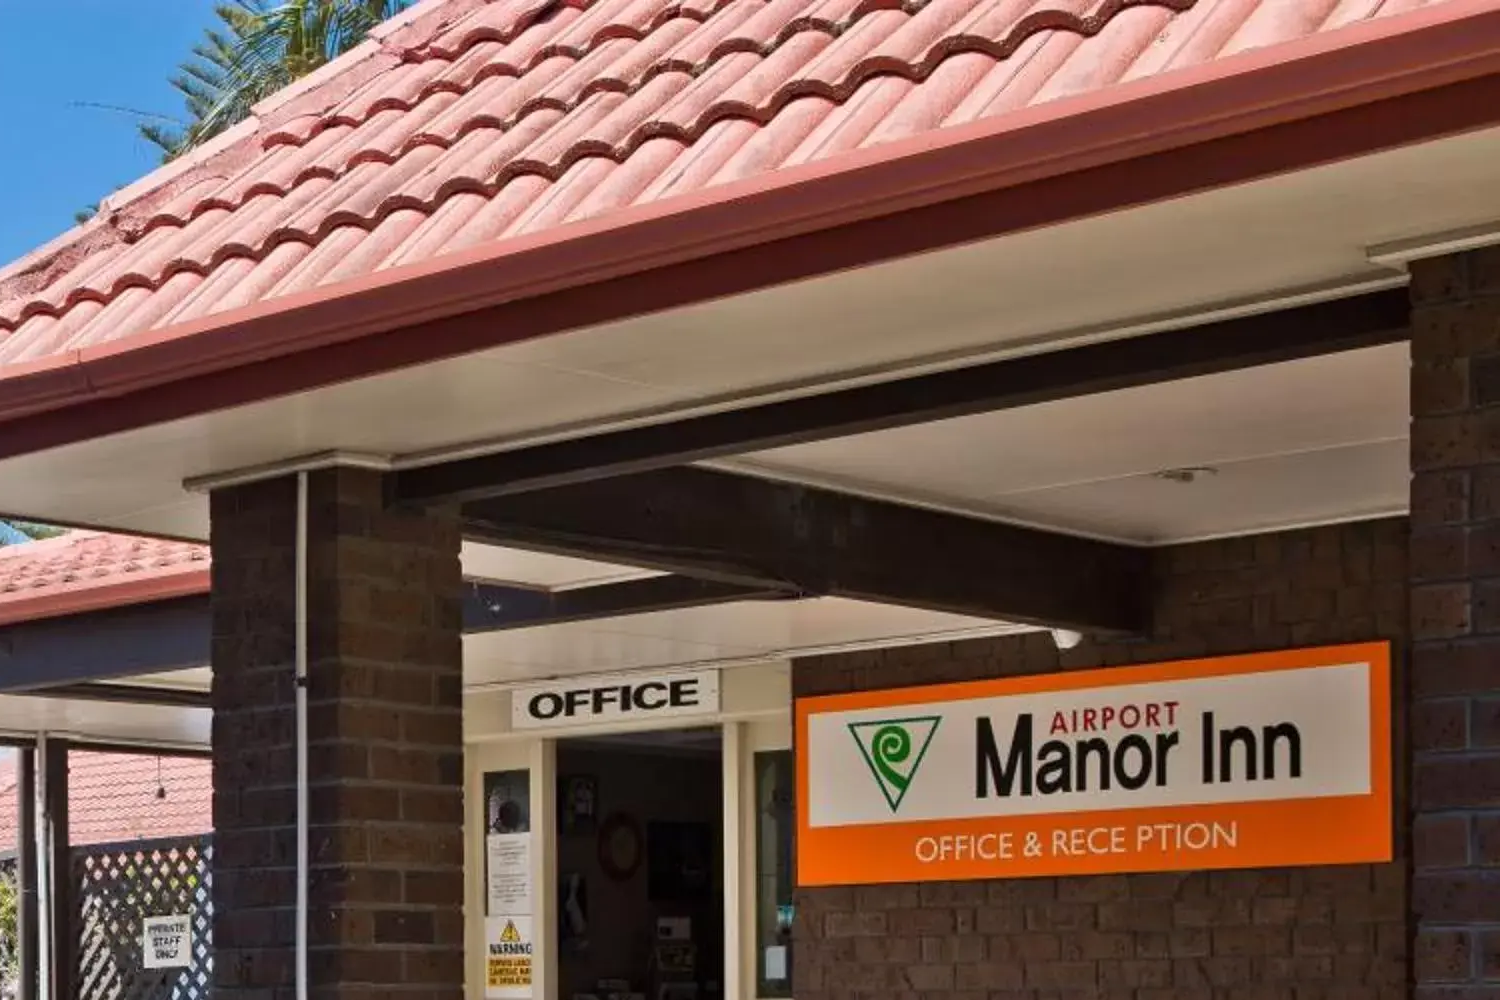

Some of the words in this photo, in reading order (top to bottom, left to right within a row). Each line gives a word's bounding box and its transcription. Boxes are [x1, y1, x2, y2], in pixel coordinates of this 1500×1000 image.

[528, 679, 699, 720] OFFICE
[1050, 701, 1180, 735] AIRPORT
[975, 713, 1180, 799] Manor
[1202, 711, 1301, 785] Inn
[915, 832, 1014, 861] OFFICE
[1022, 831, 1043, 858] &
[153, 935, 181, 948] STAFF
[489, 943, 533, 955] WARNING
